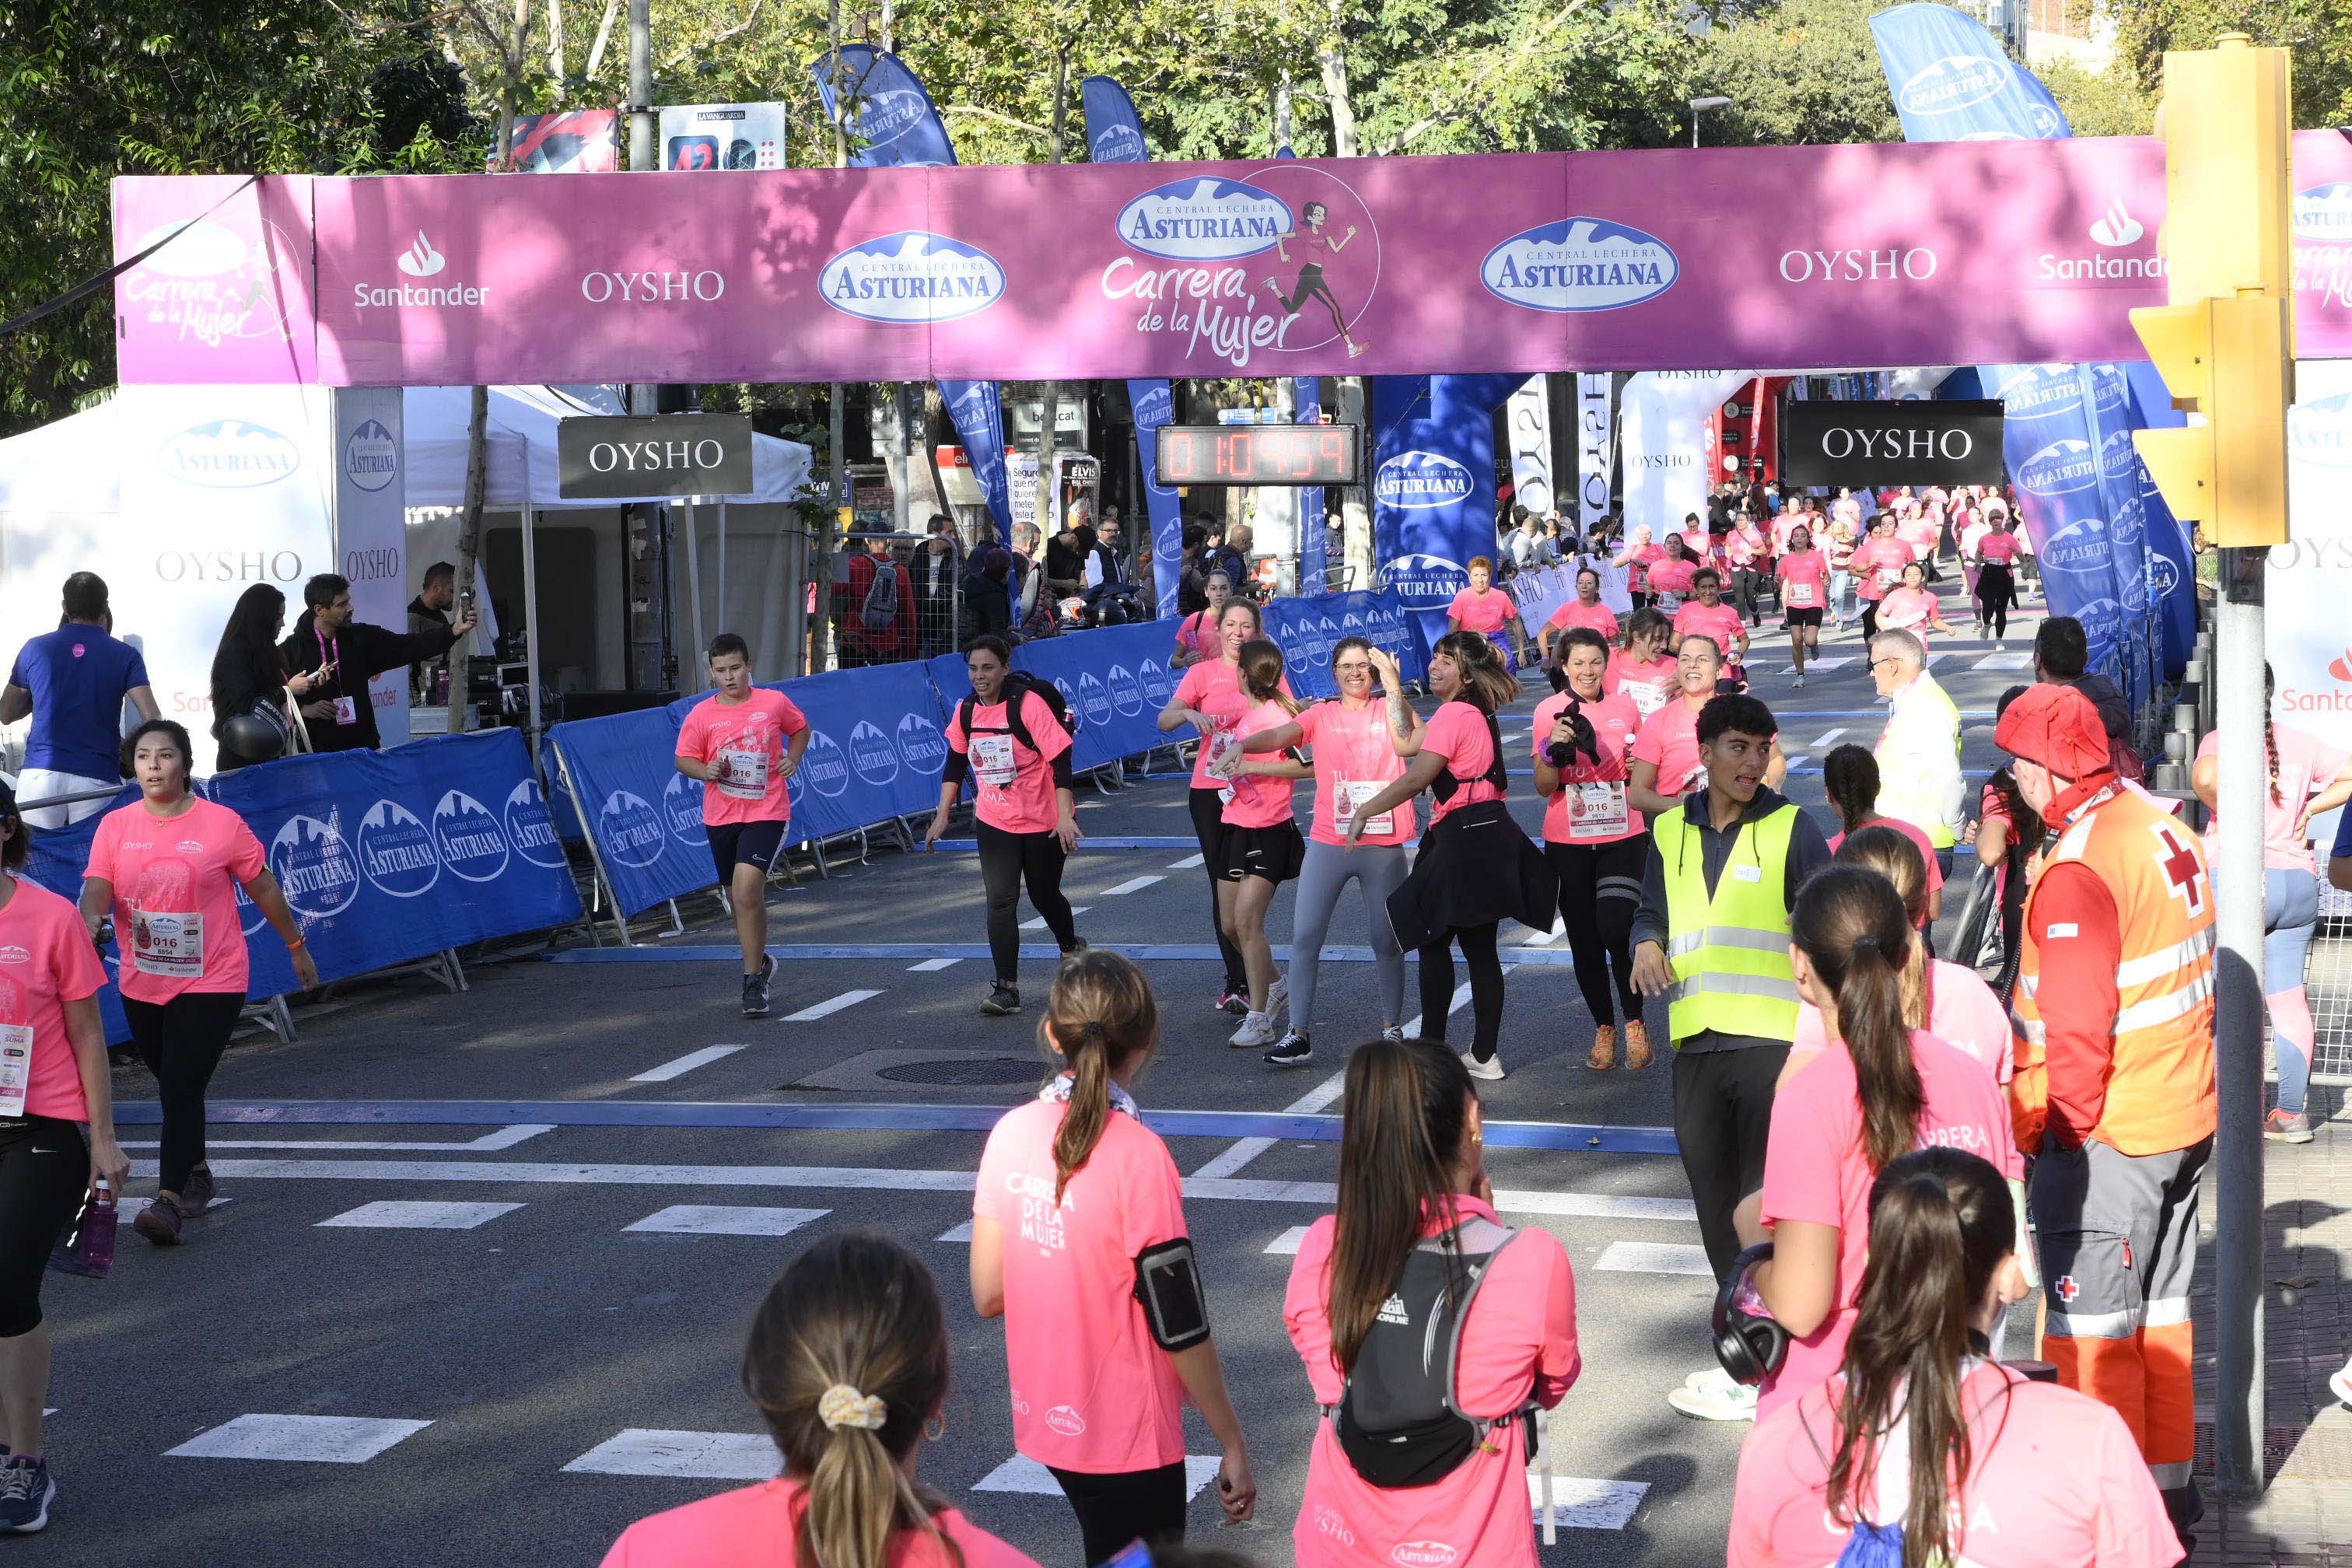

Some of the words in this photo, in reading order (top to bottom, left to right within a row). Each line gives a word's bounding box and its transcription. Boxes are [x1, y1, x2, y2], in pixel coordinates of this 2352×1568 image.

[1157, 205, 1213, 214] CENTRAL
[1218, 204, 1274, 213] LECHERA
[1130, 208, 1278, 240] ASTURIANA
[862, 262, 920, 272] CENTRAL
[926, 261, 985, 271] LECHERA
[1527, 250, 1587, 260] CENTRAL
[1594, 248, 1657, 259] LECHERA
[1780, 248, 1937, 282] OYSHO
[834, 265, 991, 299] ASTURIANA
[1101, 257, 1247, 299] Carrera
[1496, 254, 1663, 288] ASTURIANA
[355, 282, 489, 308] Santander
[582, 270, 724, 303] OYSHO
[1137, 303, 1164, 332] de
[1170, 302, 1189, 332] la
[1185, 295, 1300, 367] Mujer
[589, 439, 723, 472] OYSHO
[1822, 428, 1973, 460] OYSHO
[349, 446, 394, 474] ASTURIANA
[1072, 467, 1096, 476] ELVIS
[1633, 454, 1691, 467] OYSHO
[1014, 481, 1027, 490] que
[1379, 474, 1466, 495] ASTURIANA
[1388, 470, 1421, 478] CENTRAL
[1015, 510, 1030, 519] este
[156, 550, 303, 582] OYSHO
[348, 548, 398, 582] OYSHO
[807, 758, 846, 782] ASTURIANA
[854, 748, 896, 772] ASTURIANA
[1568, 766, 1585, 778] TU
[1332, 770, 1349, 782] TU
[1587, 803, 1608, 812] 016
[439, 828, 505, 863] ASTURIANA
[604, 820, 661, 854] ASTURIANA
[366, 839, 436, 877] ASTURIANA
[152, 937, 178, 947] 016
[1023, 1200, 1041, 1220] DE
[1045, 1207, 1063, 1227] LA
[1021, 1218, 1065, 1250] MUJER
[1400, 1548, 1452, 1563] ASTURIANA
